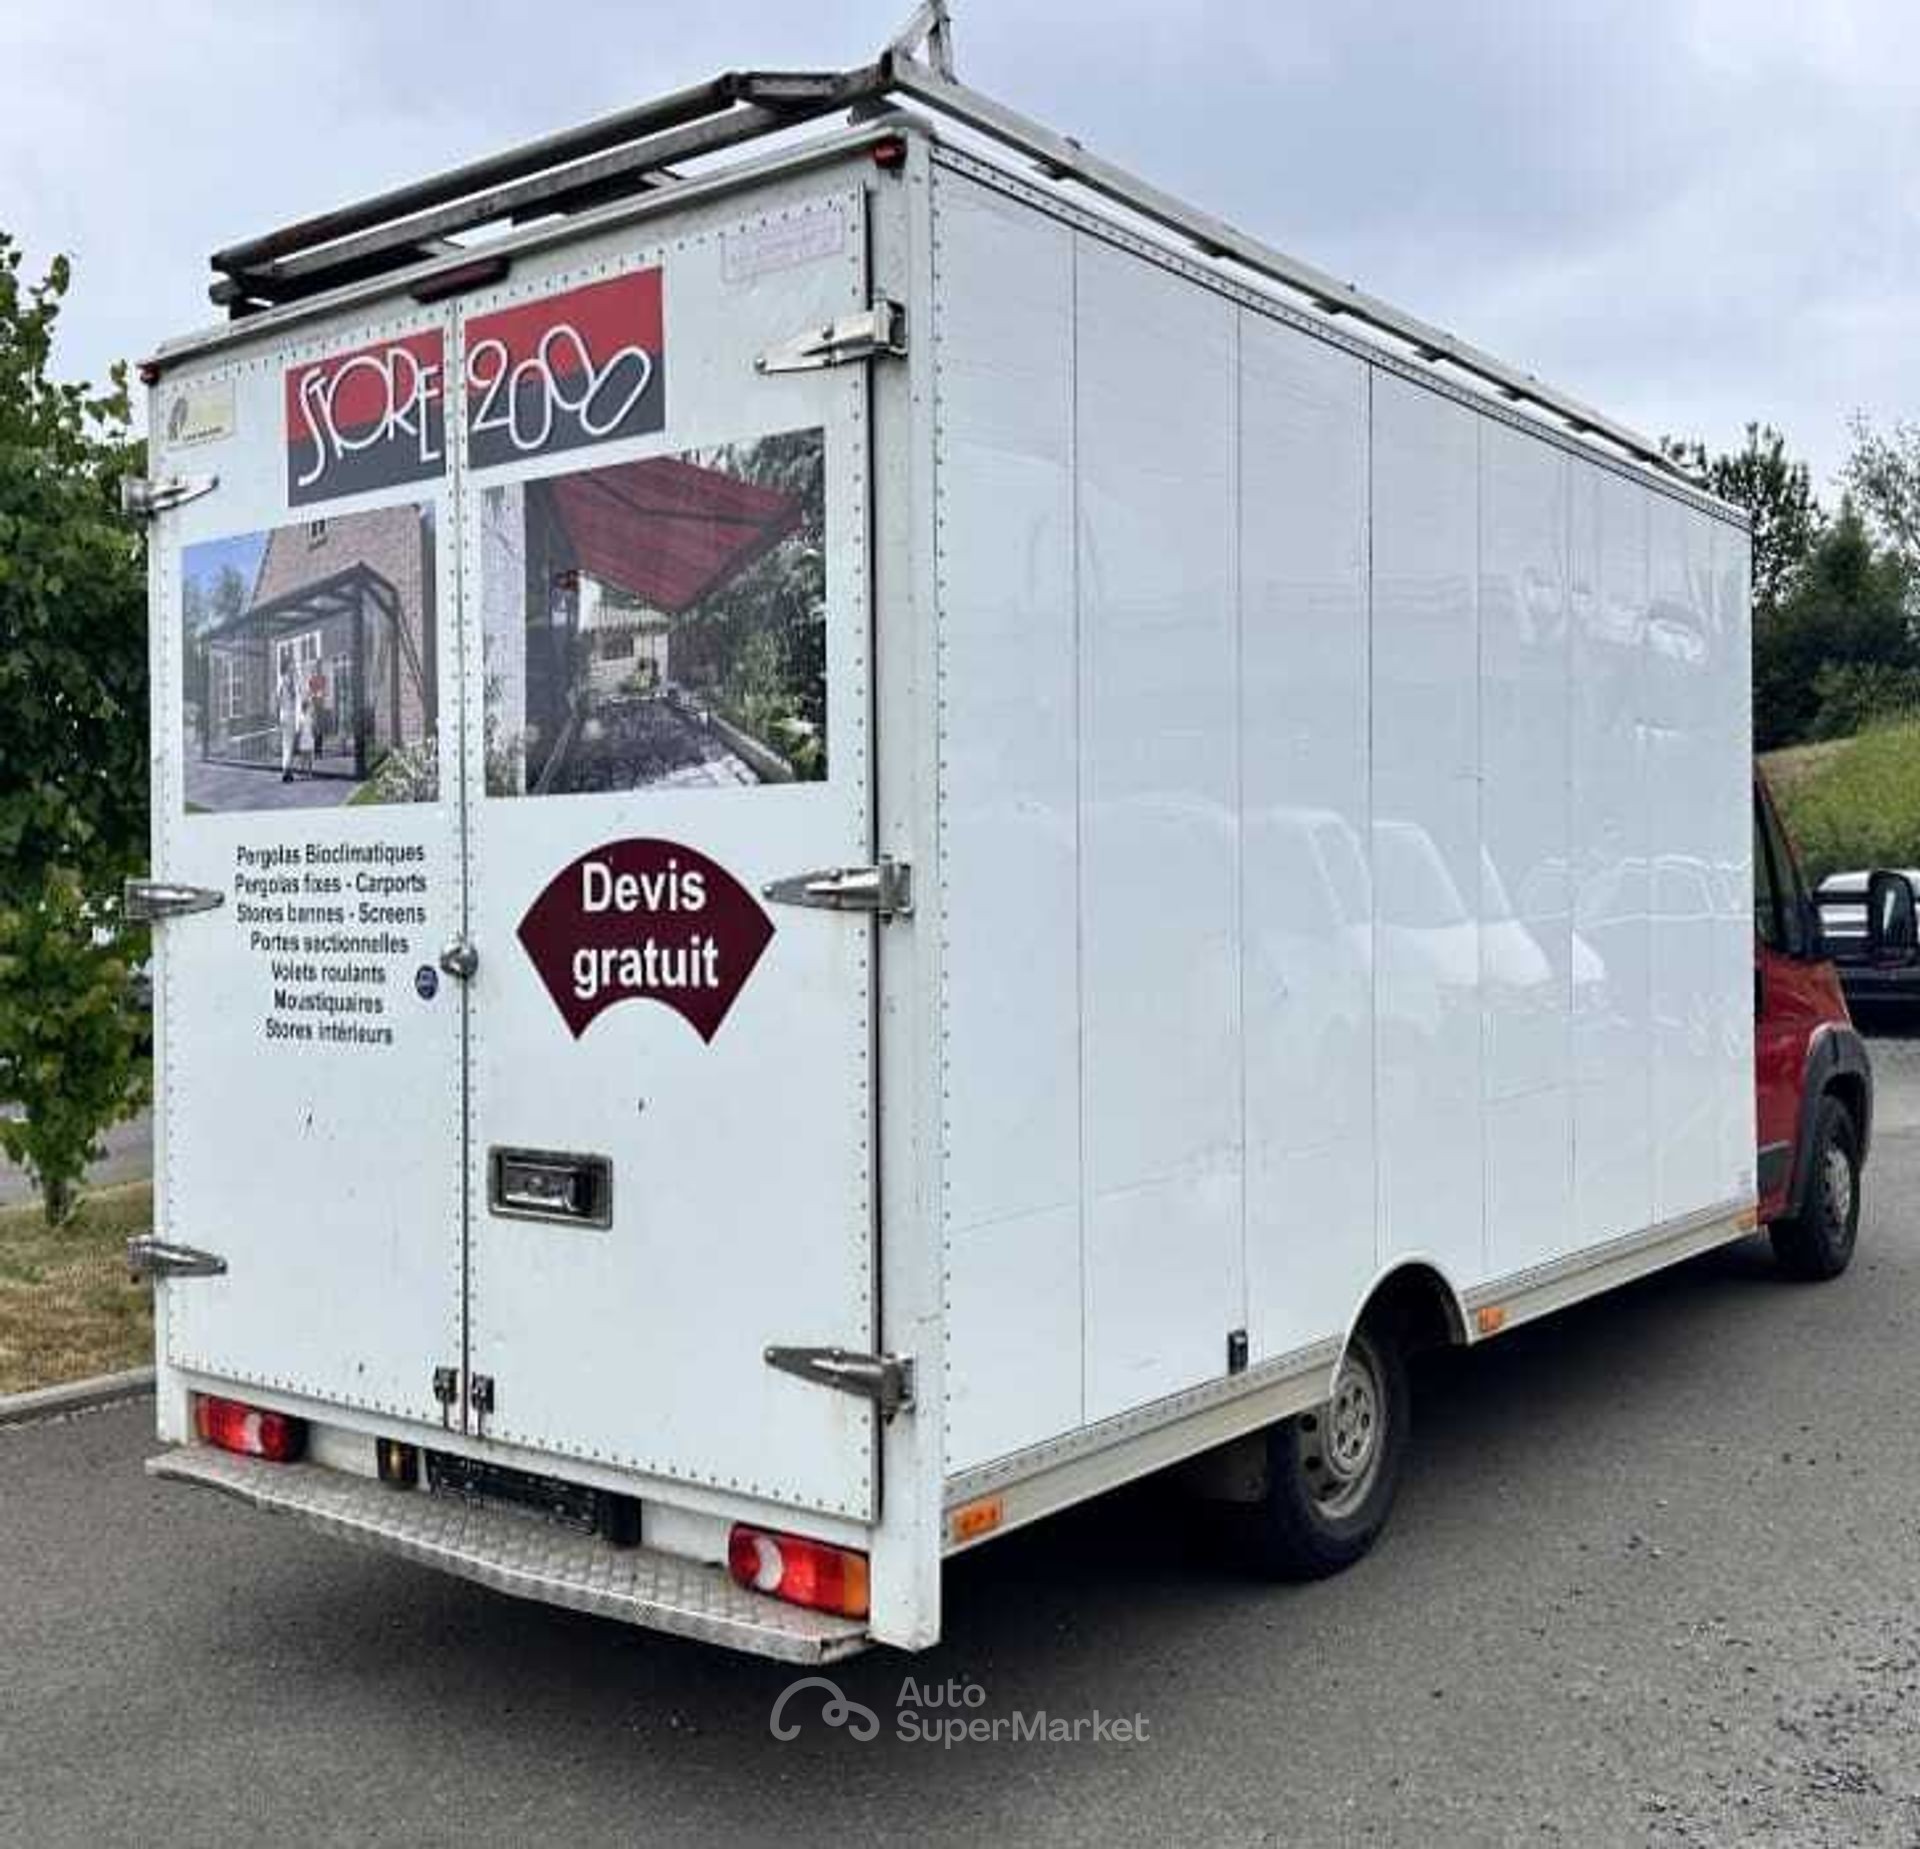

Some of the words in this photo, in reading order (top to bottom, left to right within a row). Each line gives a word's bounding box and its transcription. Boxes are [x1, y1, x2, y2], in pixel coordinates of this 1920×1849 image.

[297, 355, 442, 486] STORE
[467, 323, 651, 451] 2000
[236, 844, 301, 869] Pergolas
[305, 843, 426, 867] Bioclimatiques
[234, 873, 301, 897] Pergolas
[304, 873, 341, 892] fixes
[355, 872, 427, 897] Carports
[581, 858, 706, 912] Devis
[236, 903, 284, 923] Stores
[288, 902, 344, 923] bannes
[358, 903, 426, 923] Screens
[250, 931, 299, 952] Portes
[303, 932, 409, 954] sectionnelles
[271, 961, 317, 983] Volets
[321, 964, 386, 983] roulants
[572, 935, 719, 999] gratuit
[273, 988, 383, 1014] Moustiquaires
[265, 1018, 313, 1040] Stores
